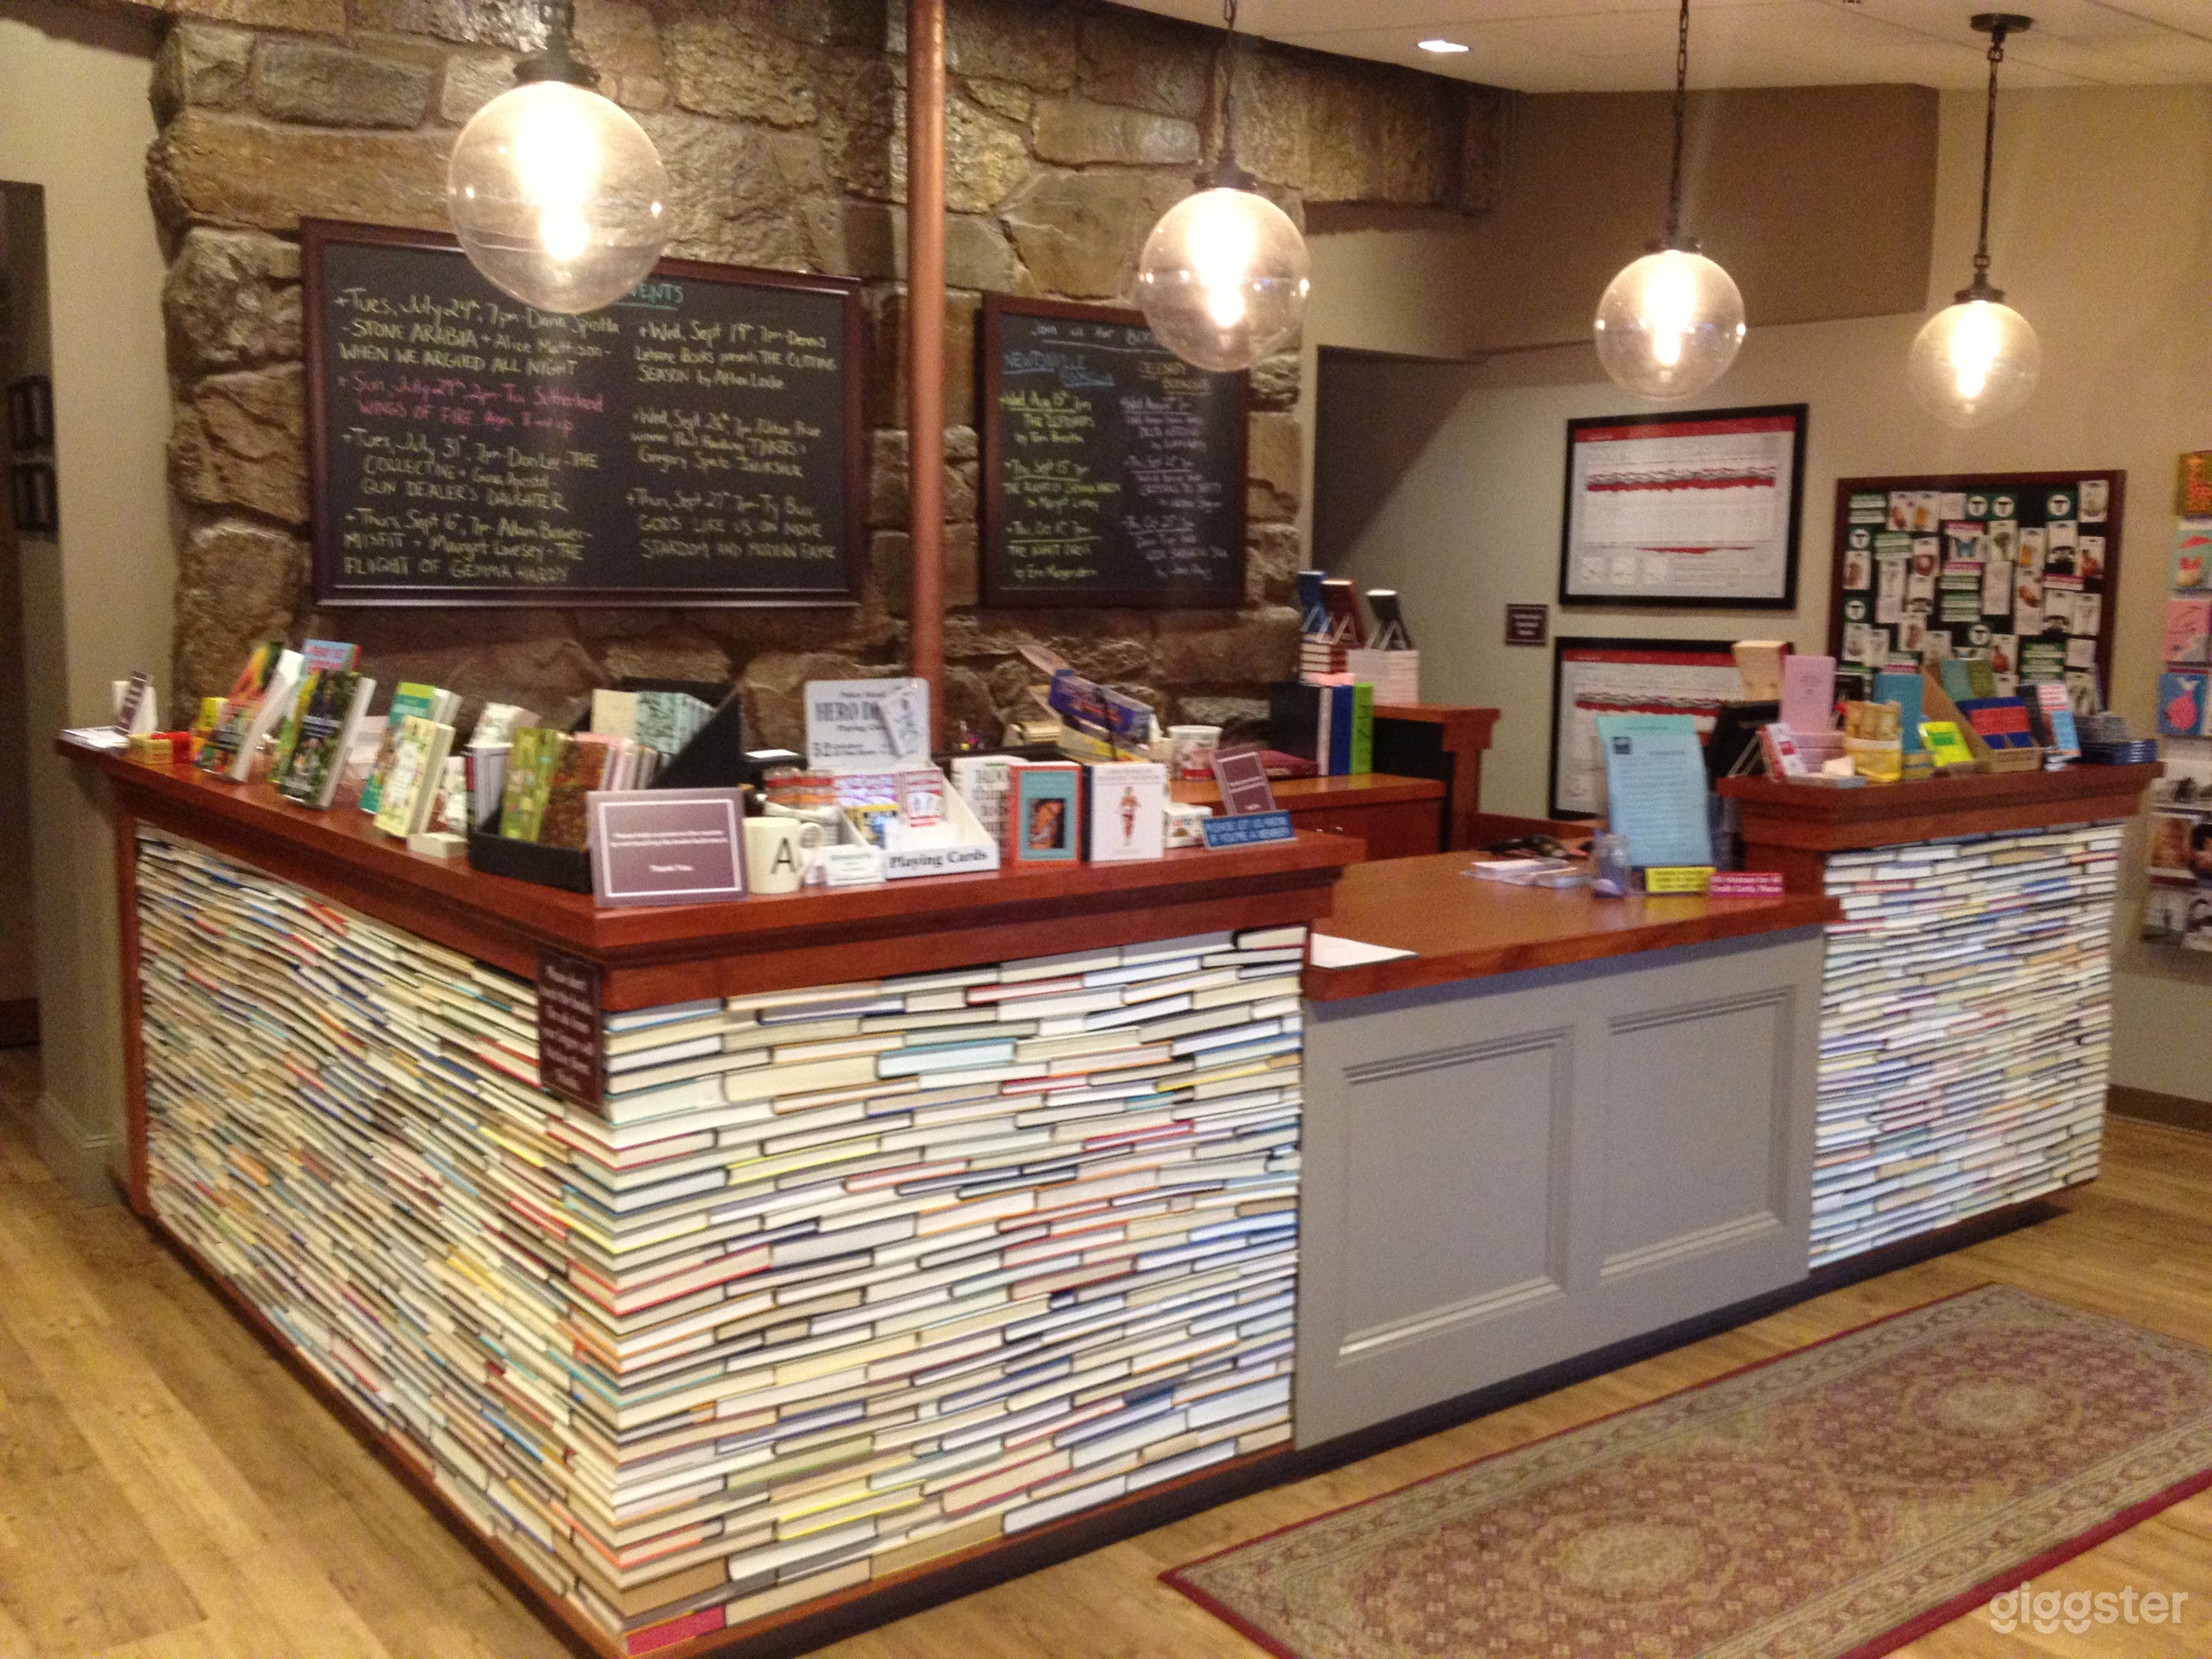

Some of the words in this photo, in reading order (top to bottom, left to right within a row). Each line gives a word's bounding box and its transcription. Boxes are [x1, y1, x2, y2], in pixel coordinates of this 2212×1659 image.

[631, 282, 684, 304] VENTS
[399, 294, 442, 326] July
[349, 318, 405, 339] STONE
[409, 323, 479, 349] ARABIA
[338, 342, 389, 363] WHEN
[394, 347, 419, 365] WE
[425, 349, 486, 371] ARGUED
[490, 356, 522, 374] ALL
[525, 357, 578, 376] NIGHT
[759, 349, 783, 366] THE
[637, 363, 690, 382] SEASON
[362, 455, 455, 482] COLLECTIVE
[569, 451, 601, 470] THE
[359, 477, 398, 496] GUN
[485, 487, 570, 513] DAUGHTER
[404, 508, 439, 536] Sept
[343, 533, 406, 550] MISFIT
[555, 541, 585, 561] THE
[639, 538, 711, 559] STARDOM
[715, 541, 743, 558] AND
[343, 556, 409, 576] FLIGHT
[418, 559, 442, 575] OF
[449, 559, 513, 580] GEMMA
[814, 700, 859, 721] HERO
[770, 837, 797, 874] A
[889, 853, 944, 870] Playing
[946, 849, 988, 863] Cards
